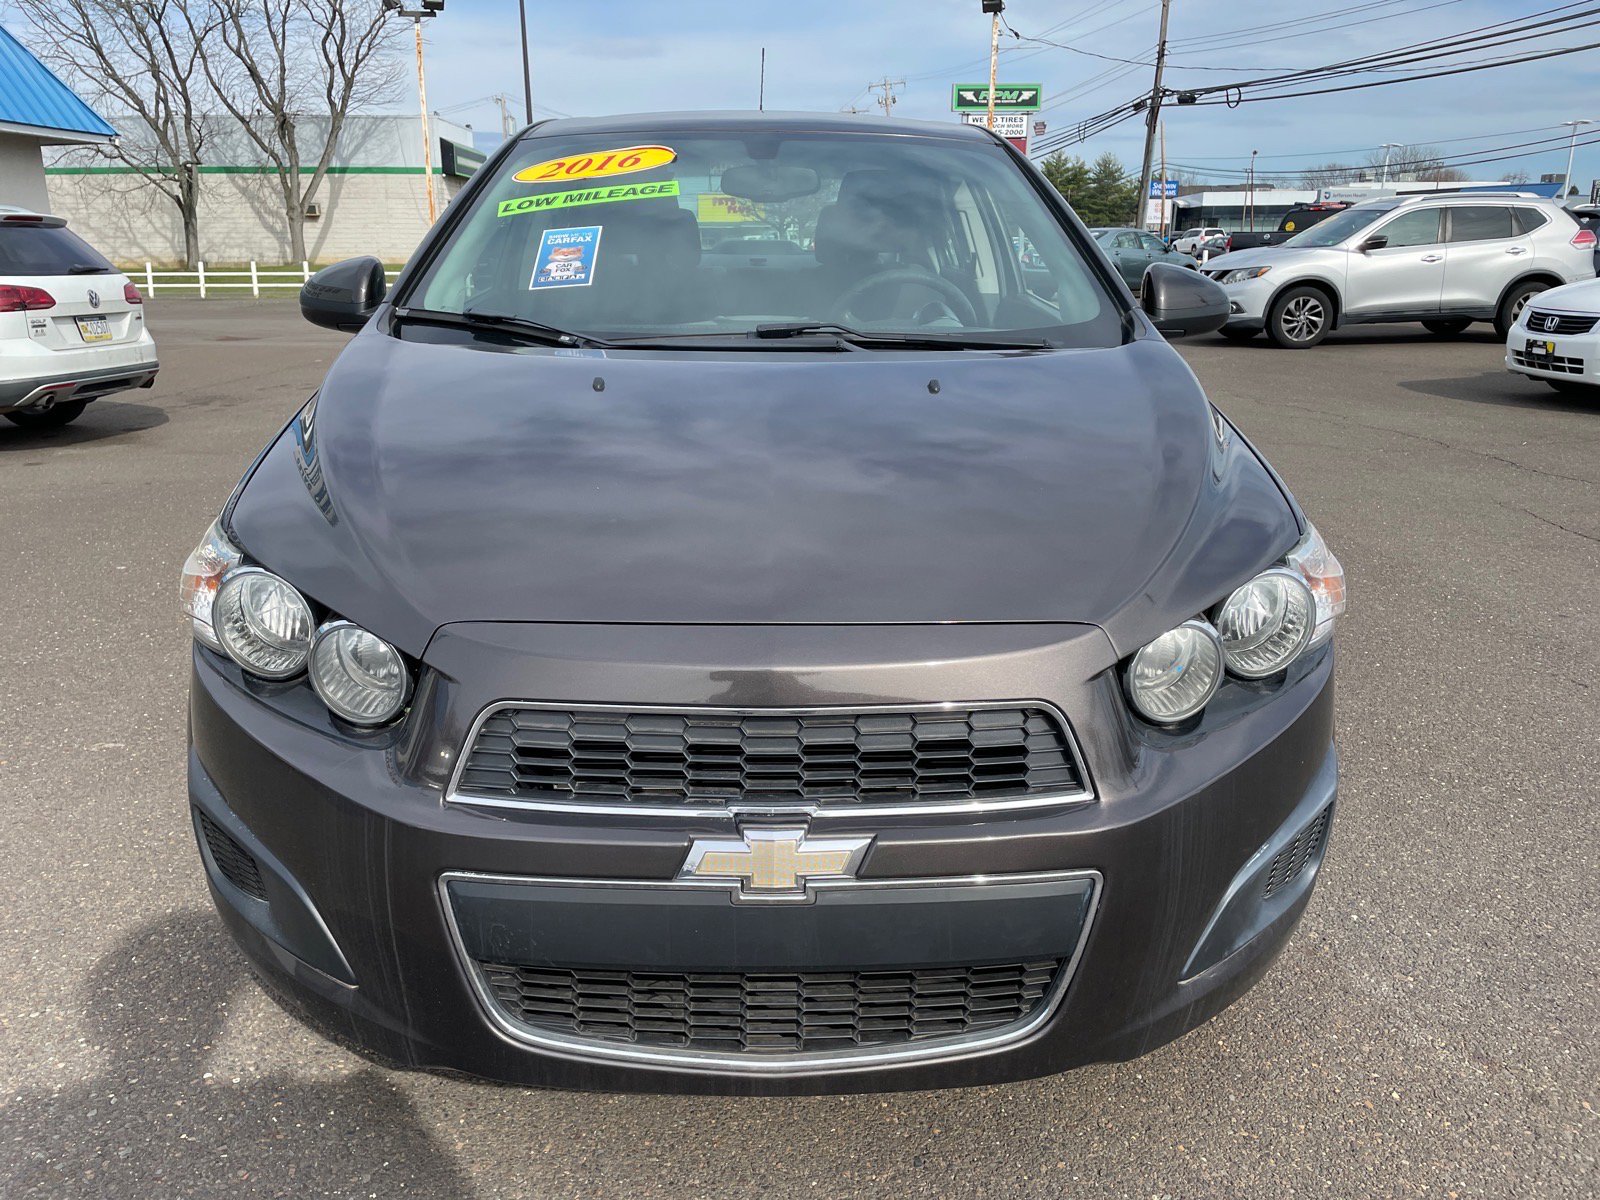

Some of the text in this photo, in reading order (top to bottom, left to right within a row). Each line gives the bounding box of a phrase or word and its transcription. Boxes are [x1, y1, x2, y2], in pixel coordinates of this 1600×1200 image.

[537, 151, 648, 180] 2016
[501, 183, 677, 213] LOW MILEAGE
[547, 235, 594, 245] CARFAX
